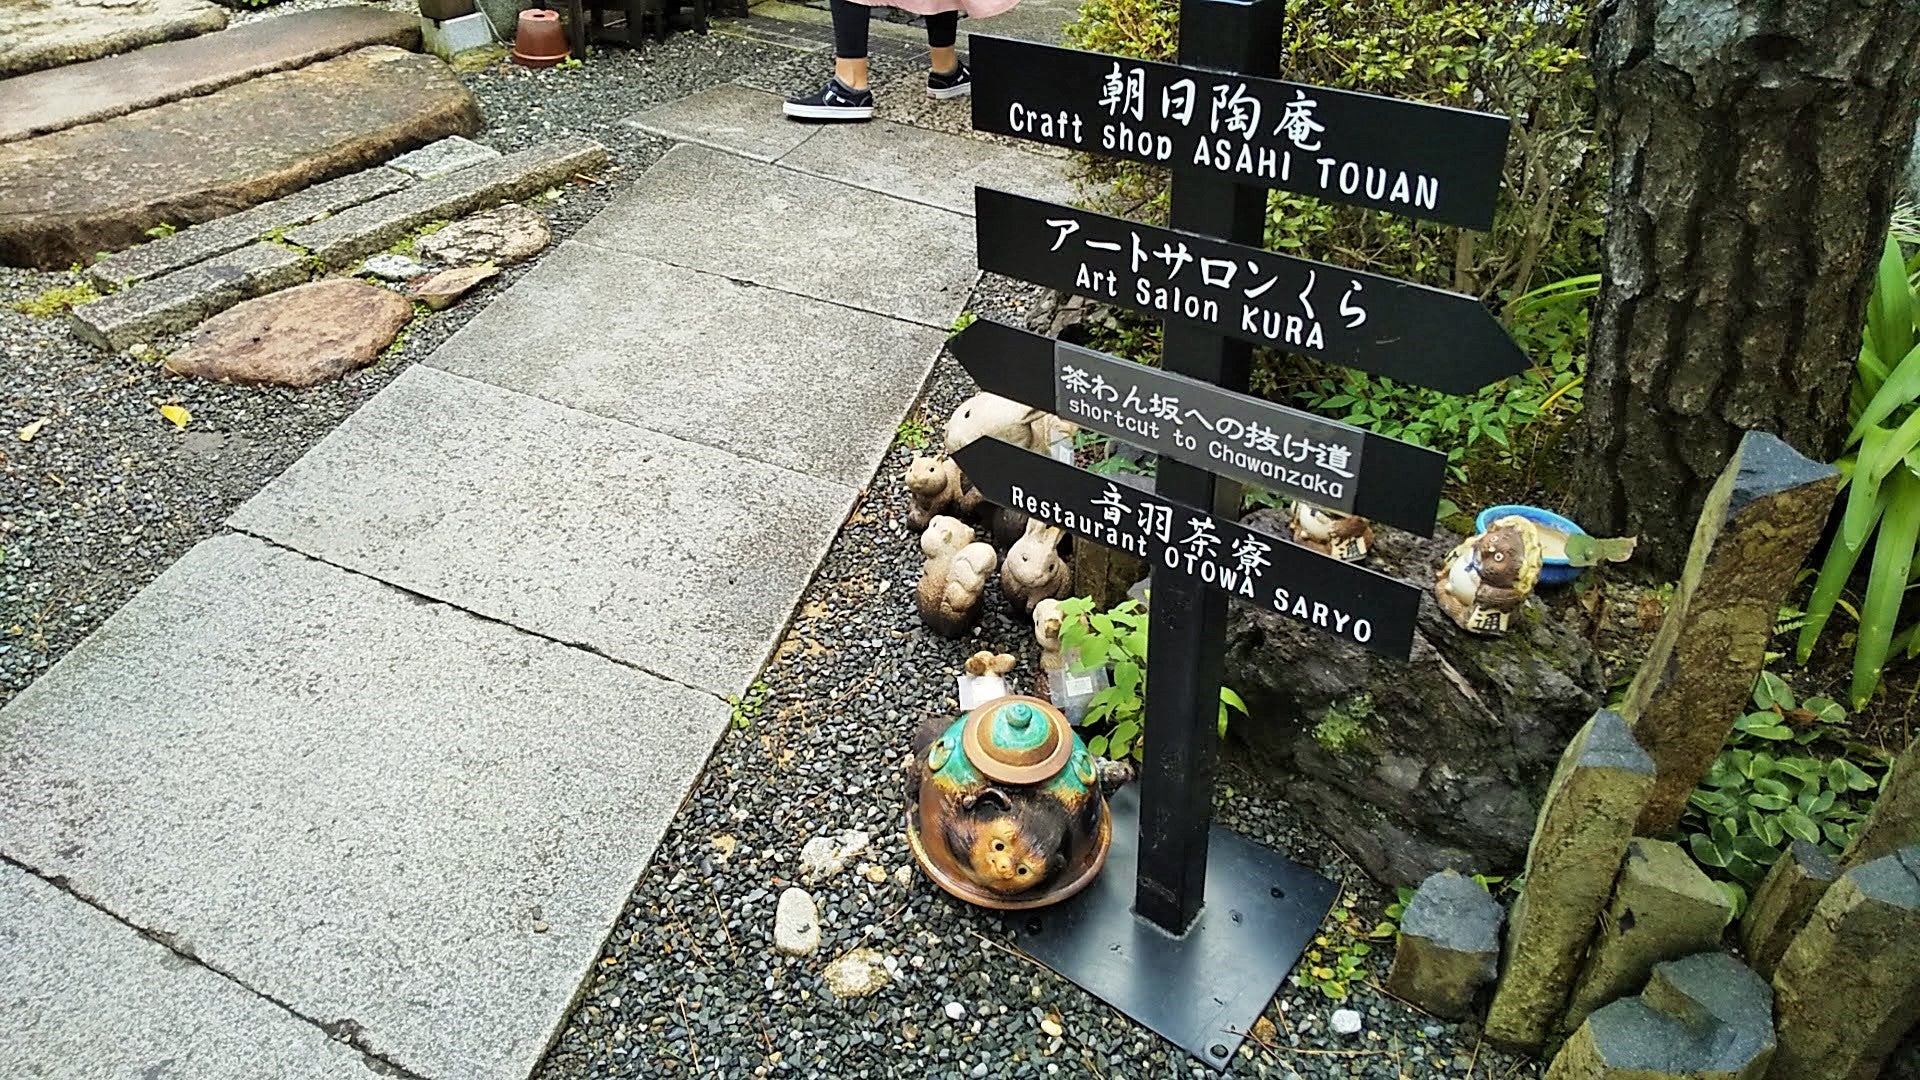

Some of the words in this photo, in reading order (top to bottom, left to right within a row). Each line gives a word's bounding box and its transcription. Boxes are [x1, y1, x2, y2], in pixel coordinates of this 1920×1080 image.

[1009, 102, 1083, 144] Craft
[1102, 121, 1172, 161] shop
[1193, 135, 1291, 181] ASAHI
[1316, 157, 1439, 210] TOUAN
[1098, 61, 1326, 152] 朝日陶庵
[1046, 218, 1367, 328] アートサロンくら
[1075, 262, 1118, 297] Art
[1135, 277, 1219, 323] Salon
[1241, 304, 1325, 350] KURA
[1061, 364, 1355, 479] 茶わん坂への抜け道
[1069, 398, 1160, 440] shortcut
[1173, 428, 1197, 451] to
[1208, 440, 1343, 499] Chawanzaka
[1012, 485, 1148, 557] Restaurant
[1164, 546, 1255, 599] OTOWA
[1273, 588, 1372, 643] SARYO
[1091, 482, 1272, 577] 音羽茶寮
